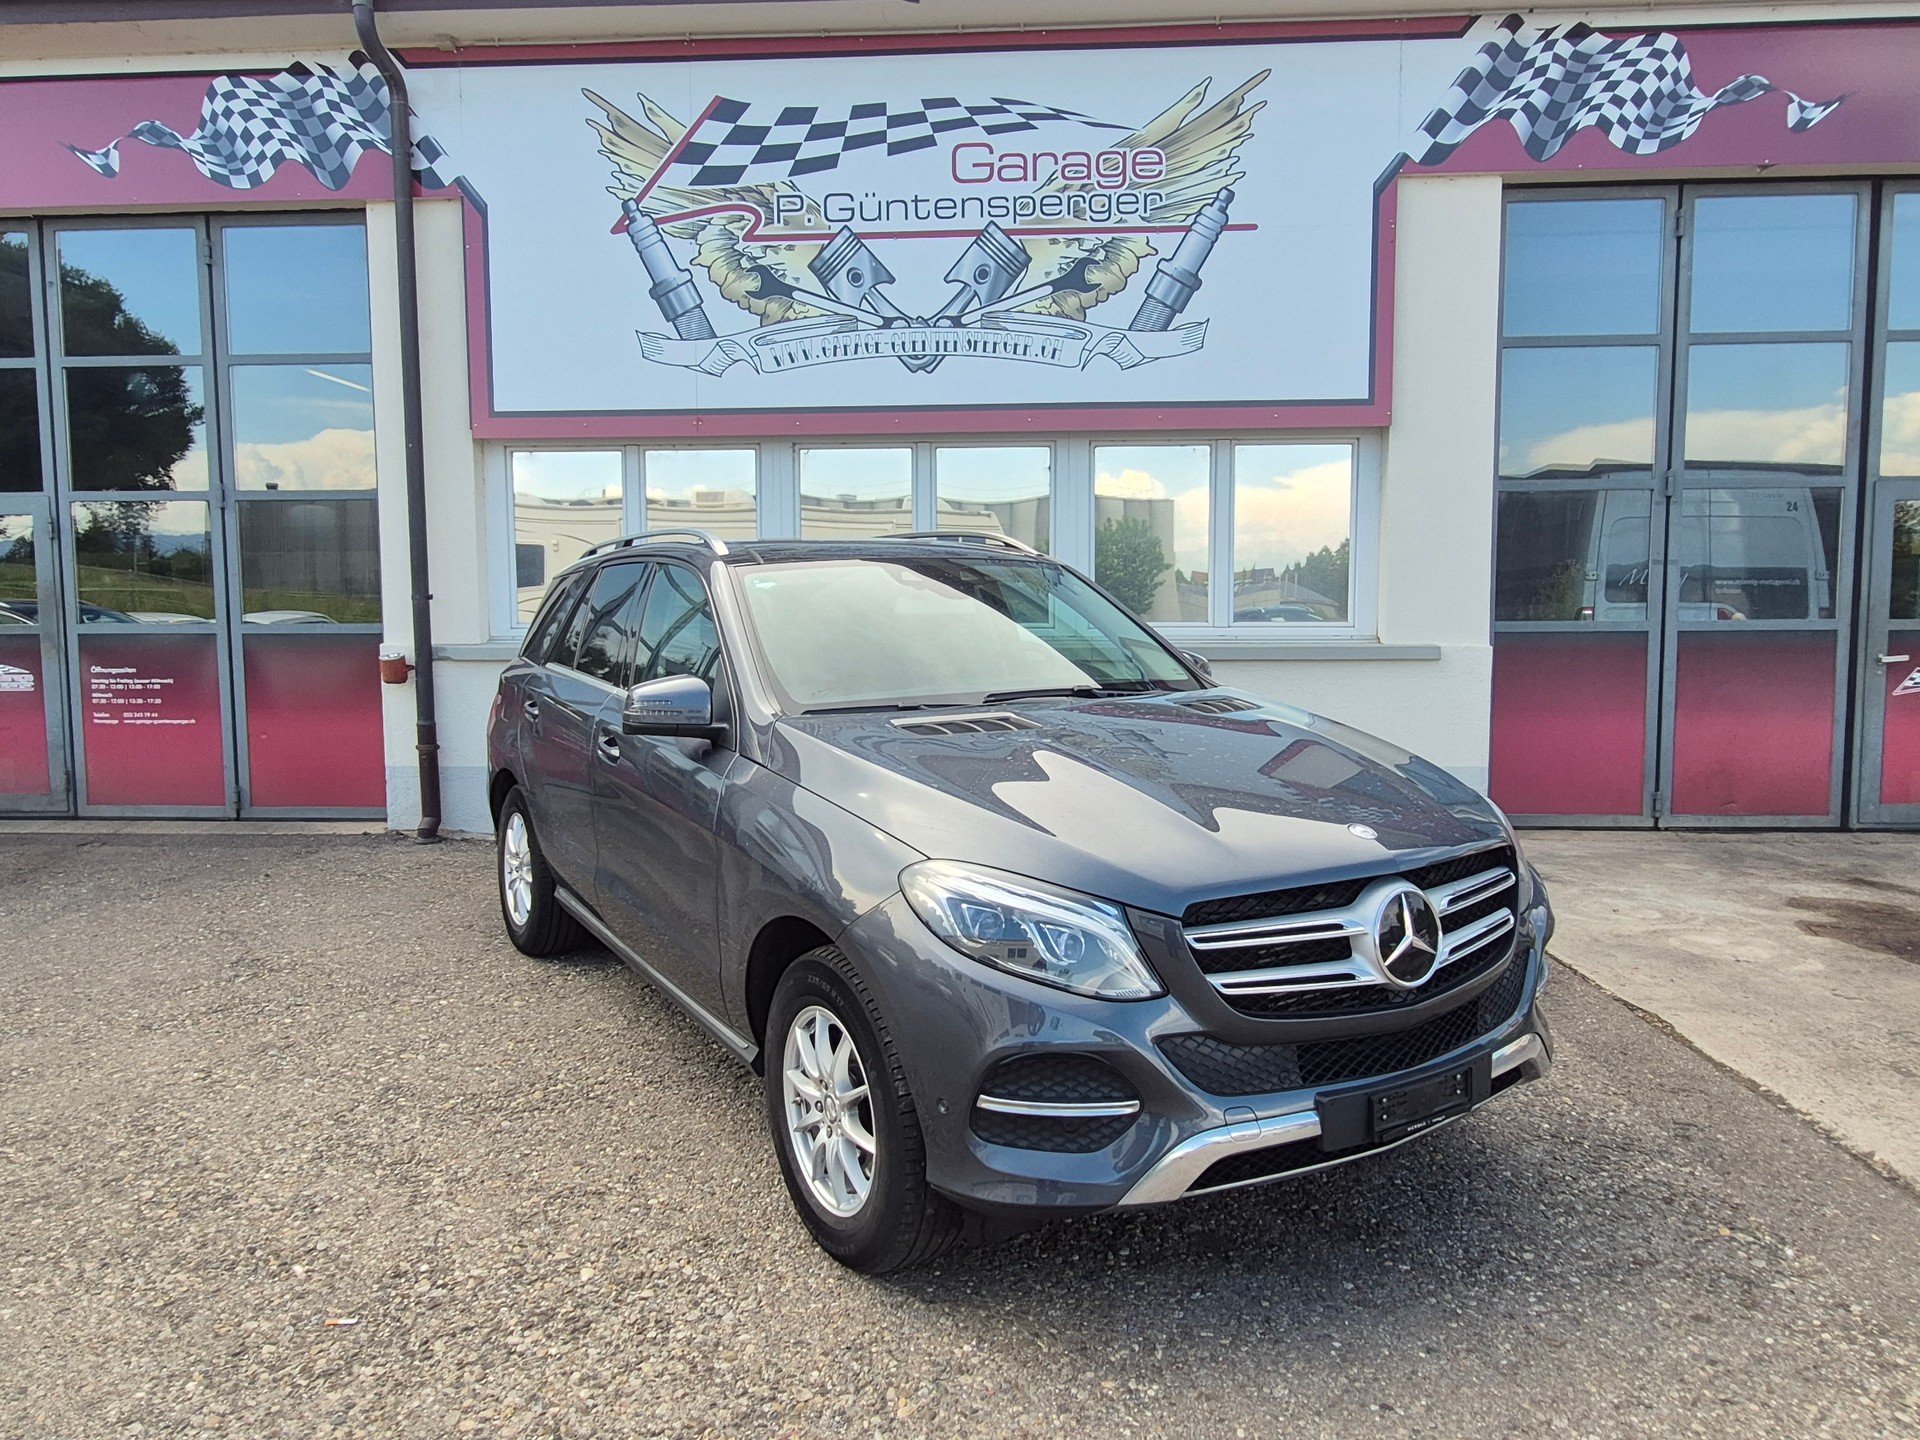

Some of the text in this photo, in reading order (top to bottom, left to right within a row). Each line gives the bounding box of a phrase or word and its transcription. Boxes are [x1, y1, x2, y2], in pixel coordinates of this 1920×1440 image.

[951, 142, 1163, 189] Garage
[776, 192, 1163, 225] P. Güntensperger
[1786, 501, 1799, 512] 24
